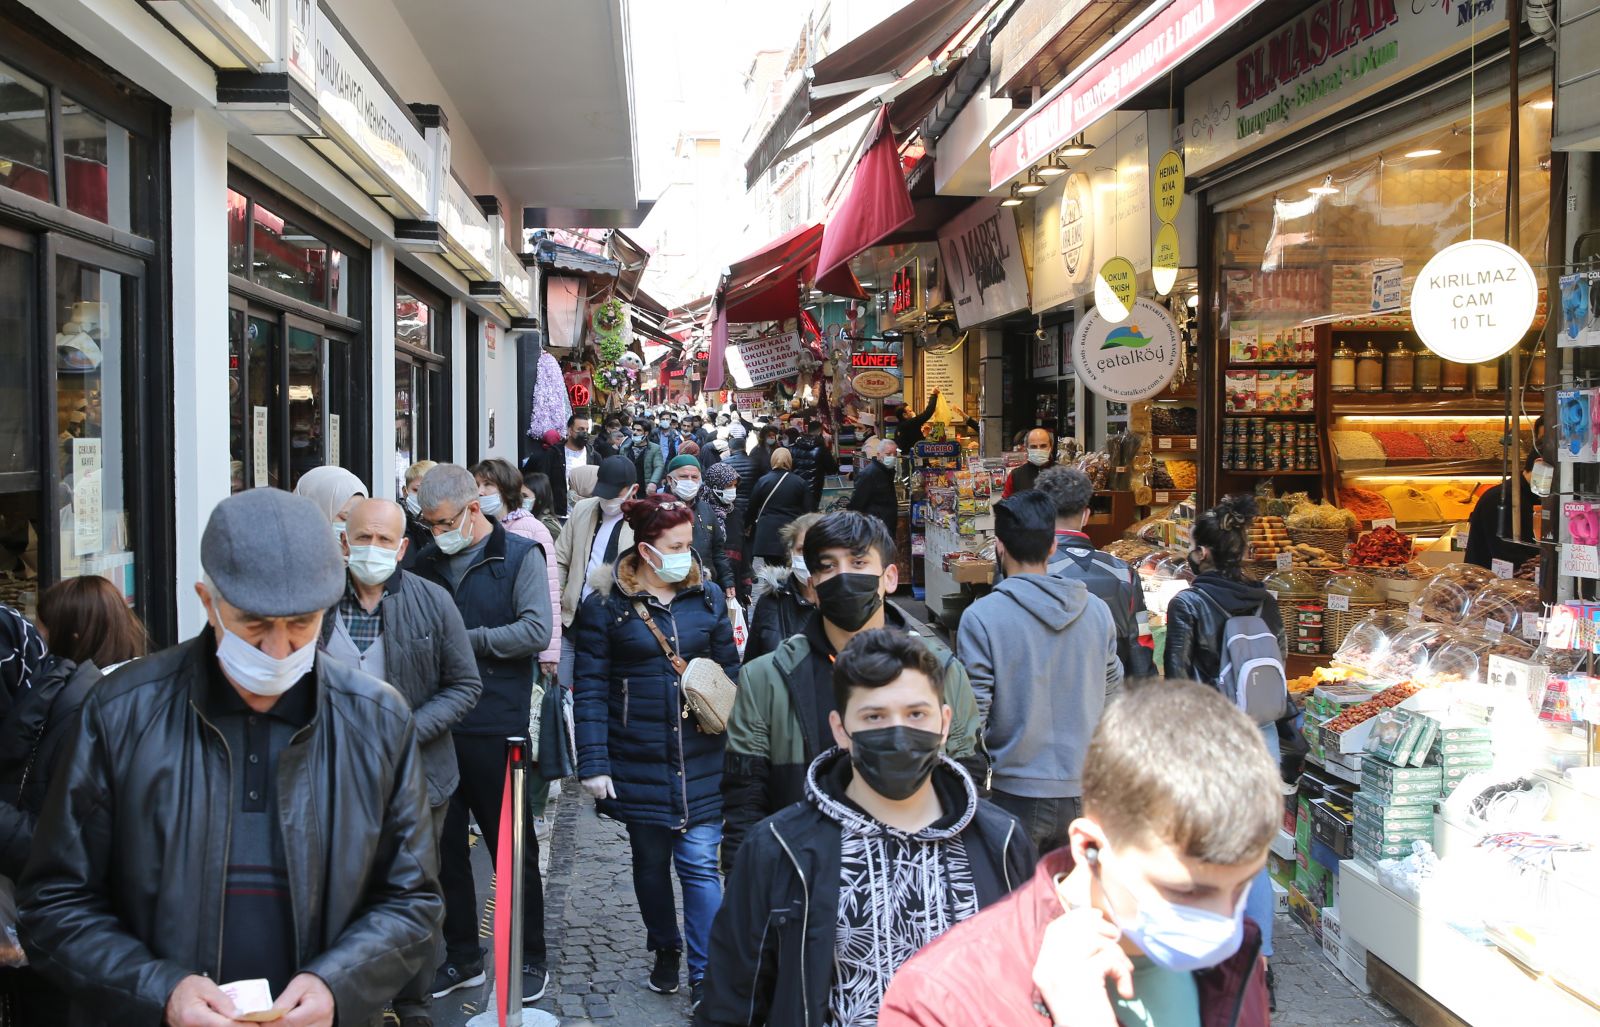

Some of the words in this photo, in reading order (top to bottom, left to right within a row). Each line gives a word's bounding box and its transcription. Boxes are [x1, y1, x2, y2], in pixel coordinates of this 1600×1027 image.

[1351, 40, 1398, 81] Lokum
[1430, 267, 1517, 289] KIRILMAZ
[1110, 283, 1130, 294] RKISH
[1452, 292, 1493, 309] CAM
[1451, 315, 1469, 330] 10
[1475, 313, 1497, 328] TL
[740, 342, 766, 354] LIKON
[768, 335, 793, 347] KALIP
[743, 349, 773, 361] OKULU
[745, 358, 769, 369] KULU
[770, 350, 799, 362] SABUN
[852, 351, 898, 367] KÜNEFE
[1096, 345, 1165, 373] çatalköy
[749, 362, 787, 375] PASTANE
[865, 377, 886, 386] Safa
[1557, 391, 1575, 399] COLOR
[925, 444, 954, 453] HARIBO
[1564, 503, 1585, 512] COLOR
